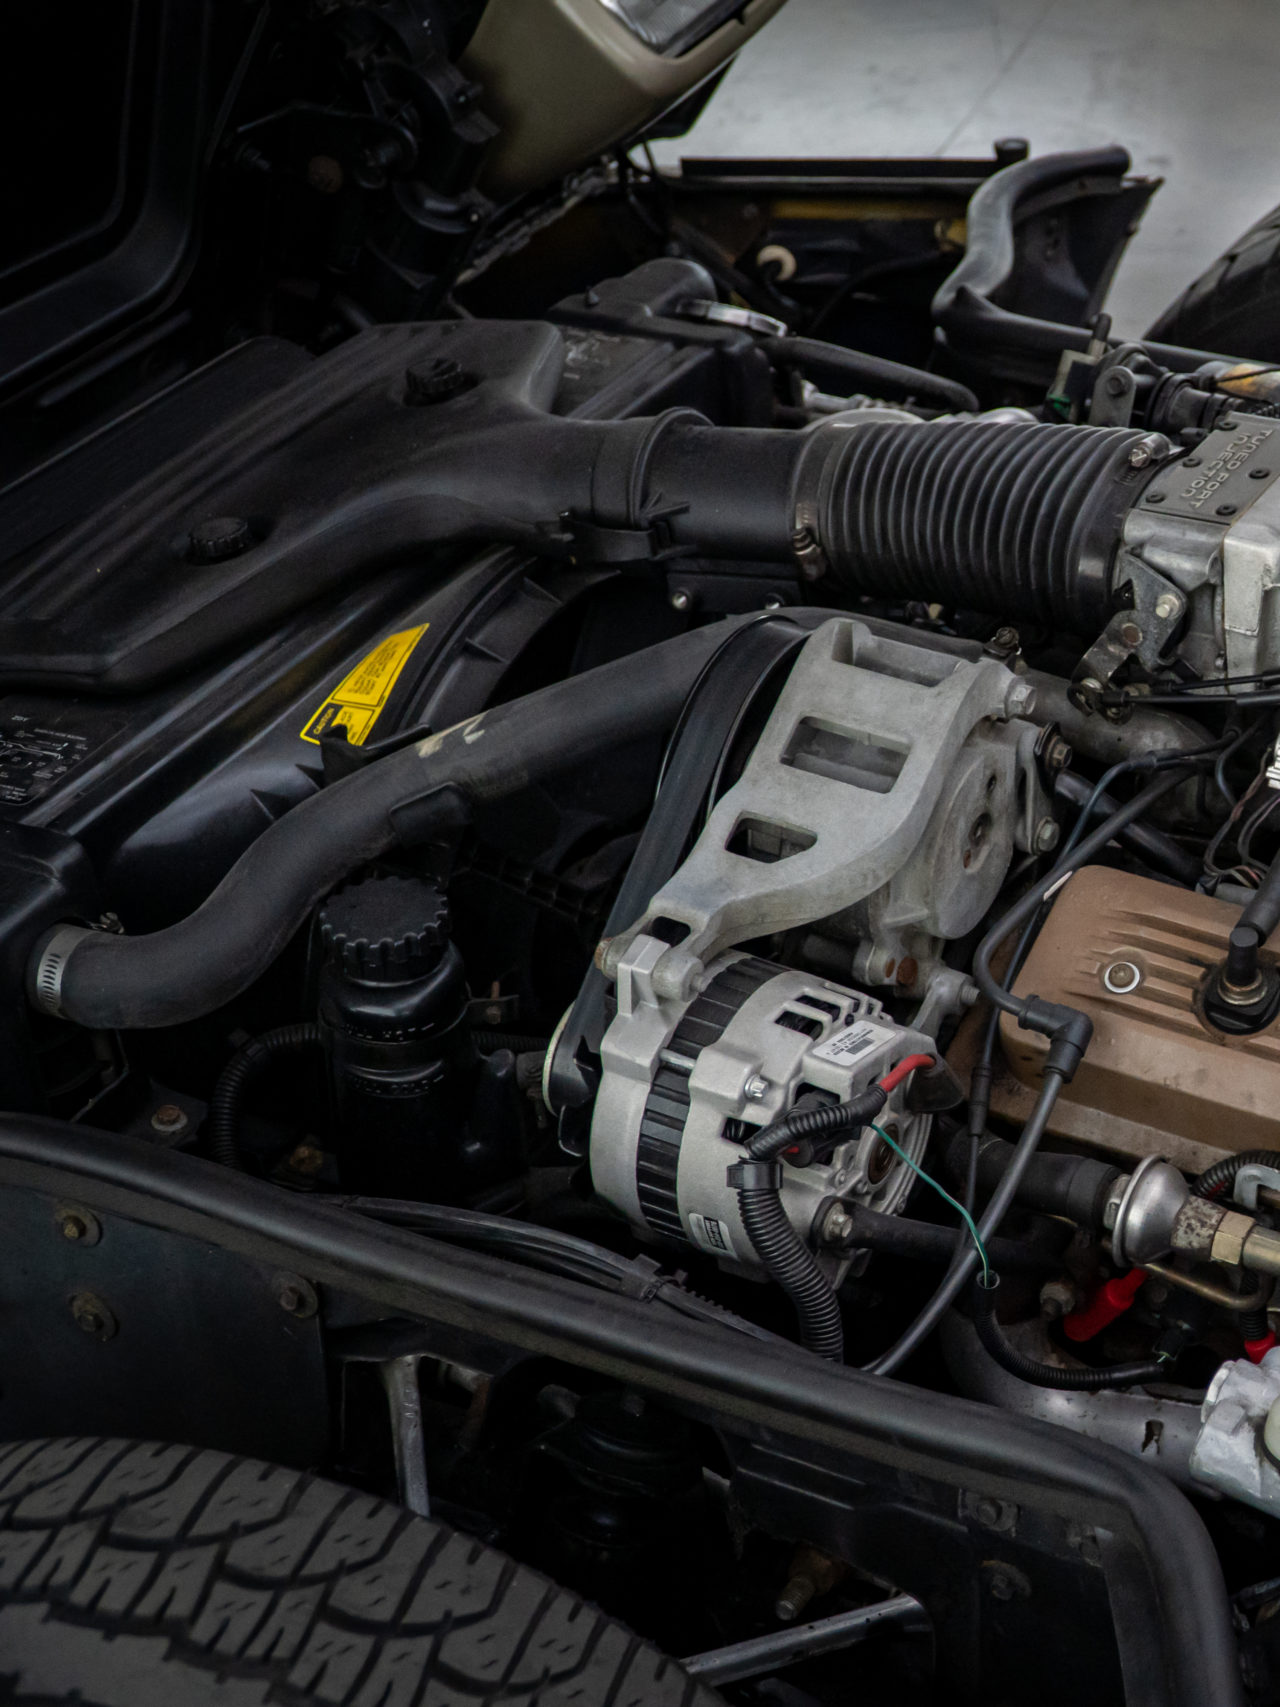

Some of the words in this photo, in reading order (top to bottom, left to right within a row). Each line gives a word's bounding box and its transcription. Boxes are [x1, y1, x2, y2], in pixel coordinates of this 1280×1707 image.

[1181, 433, 1252, 498] INJECTION
[1226, 429, 1273, 470] TUNED
[1189, 472, 1230, 509] PORT
